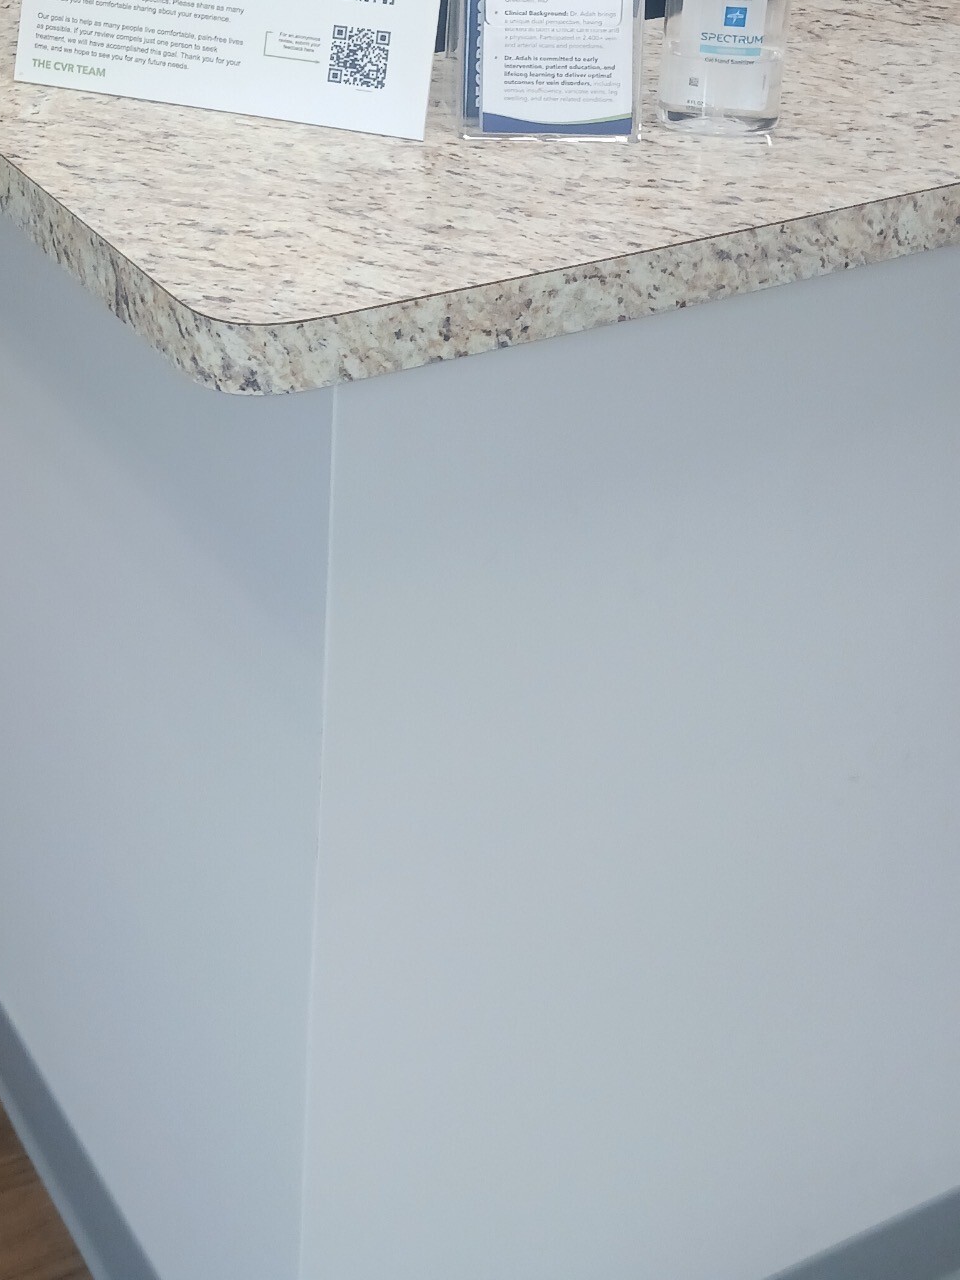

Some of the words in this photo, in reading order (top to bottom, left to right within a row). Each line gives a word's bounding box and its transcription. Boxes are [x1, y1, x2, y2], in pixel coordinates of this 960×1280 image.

[132, 3, 157, 14] sharing
[157, 7, 176, 15] about
[195, 1, 215, 9] share
[225, 6, 244, 15] many
[50, 13, 64, 23] goal
[78, 17, 93, 26] help
[102, 22, 120, 30] many
[121, 22, 143, 33] people
[156, 27, 197, 40] comfortable,
[197, 32, 227, 44] pain-free
[228, 36, 244, 44] lives
[701, 32, 764, 44] SPECTRUM
[32, 58, 51, 69] THE
[52, 61, 74, 72] CVR
[75, 64, 106, 76] TEAM
